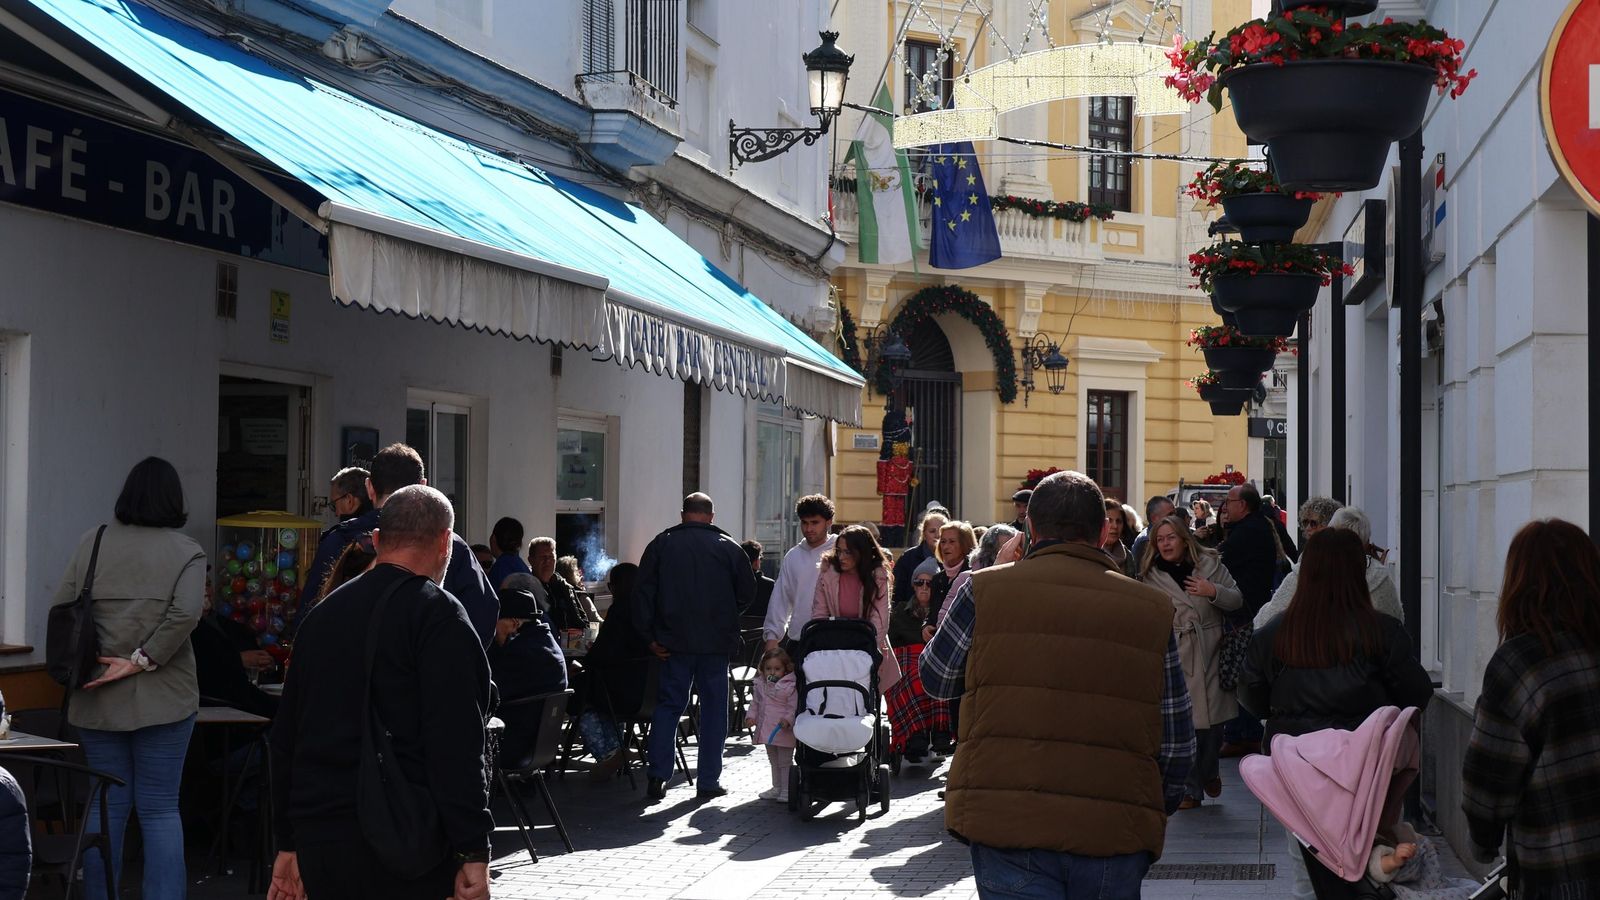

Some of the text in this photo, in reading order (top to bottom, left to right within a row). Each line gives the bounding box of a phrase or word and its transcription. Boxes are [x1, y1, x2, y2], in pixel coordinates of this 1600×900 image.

[145, 160, 235, 239] BAR
[677, 329, 701, 369] BAR
[714, 341, 767, 386] CENTRAL
